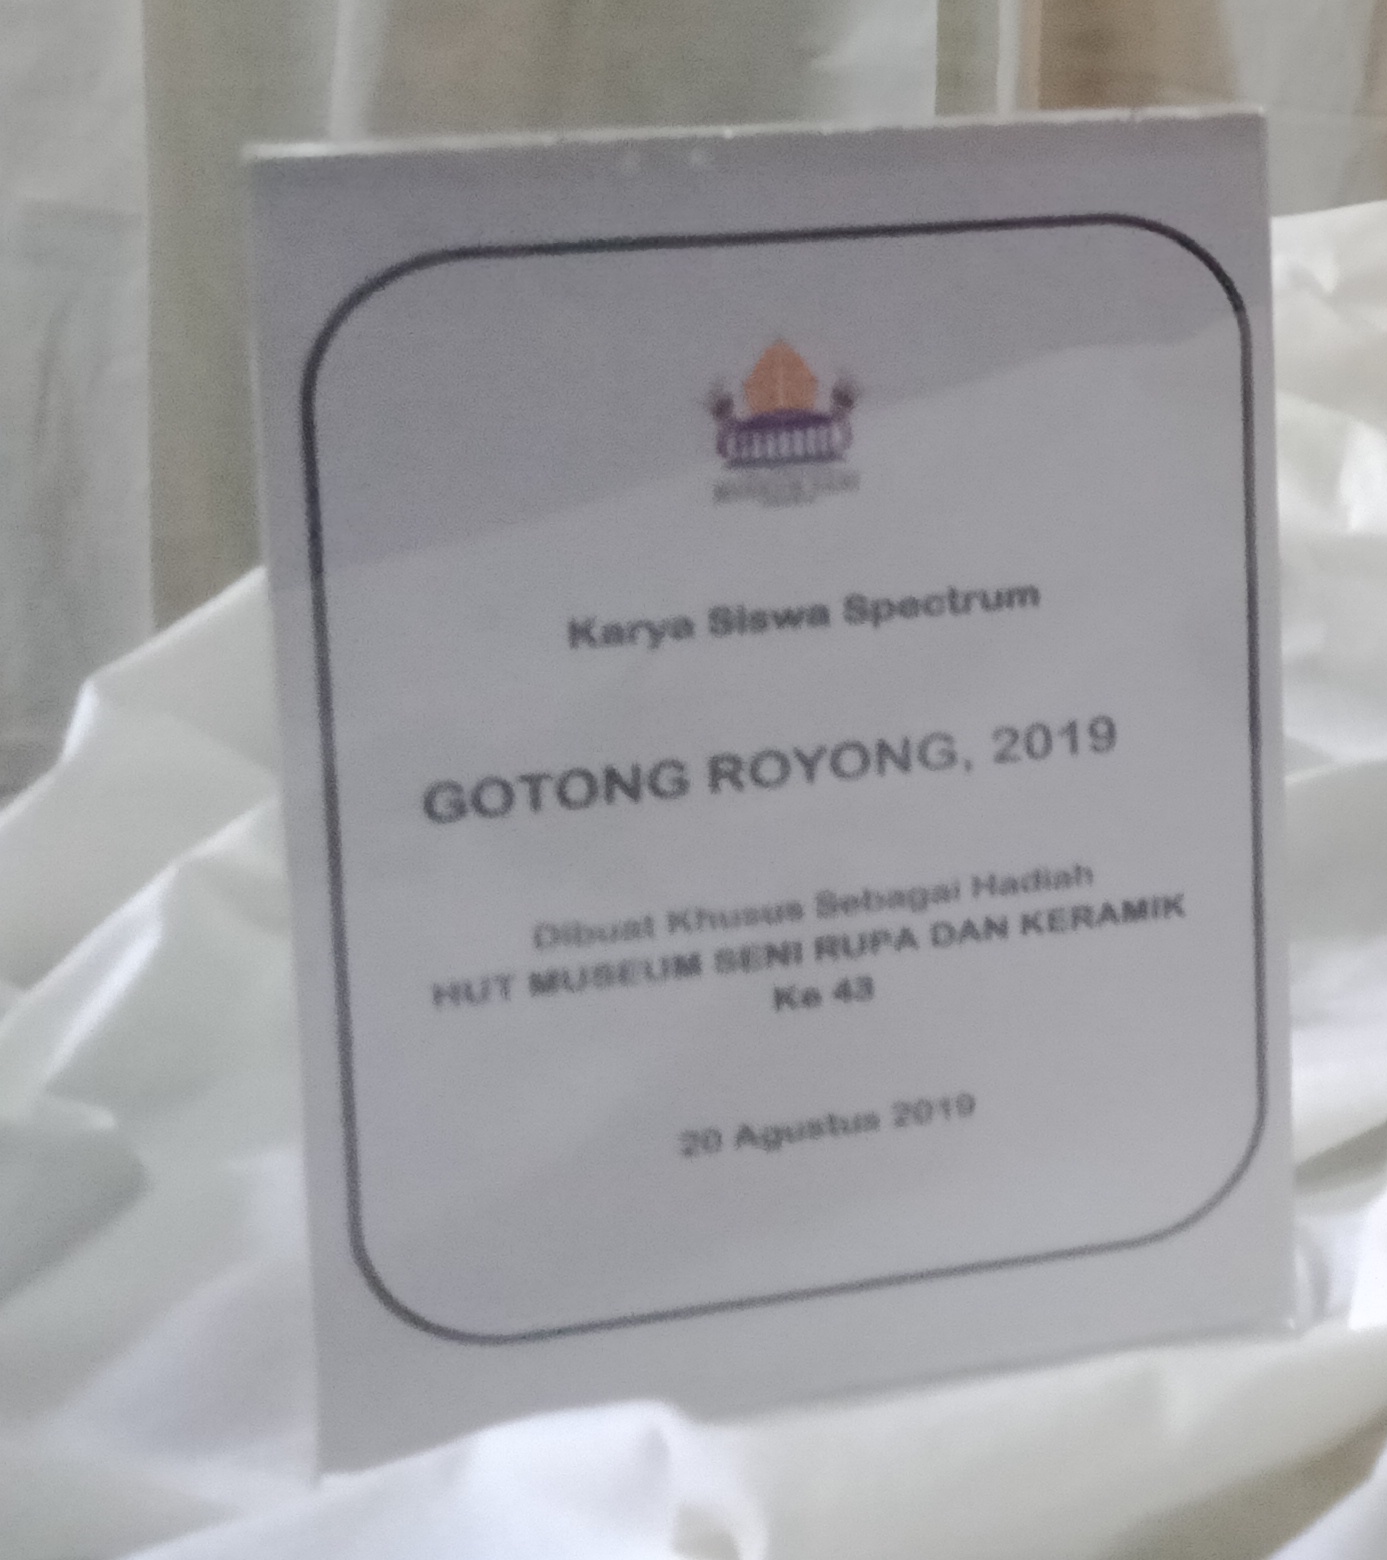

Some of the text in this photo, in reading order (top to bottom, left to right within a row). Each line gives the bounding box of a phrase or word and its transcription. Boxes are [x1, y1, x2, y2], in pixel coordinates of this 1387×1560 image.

[568, 584, 1042, 650] Karya Siswa Spectrum
[421, 715, 1118, 824] GOTONG ROYONG, 2019
[532, 862, 1094, 949] Dibuat Khusus Sebagai Hadiah
[431, 892, 1186, 1008] HUT MUSEUM SENI RUPA DAN KERAMIK
[772, 975, 875, 1012] Ke 43
[679, 1092, 976, 1157] 20 Agustus 2019
